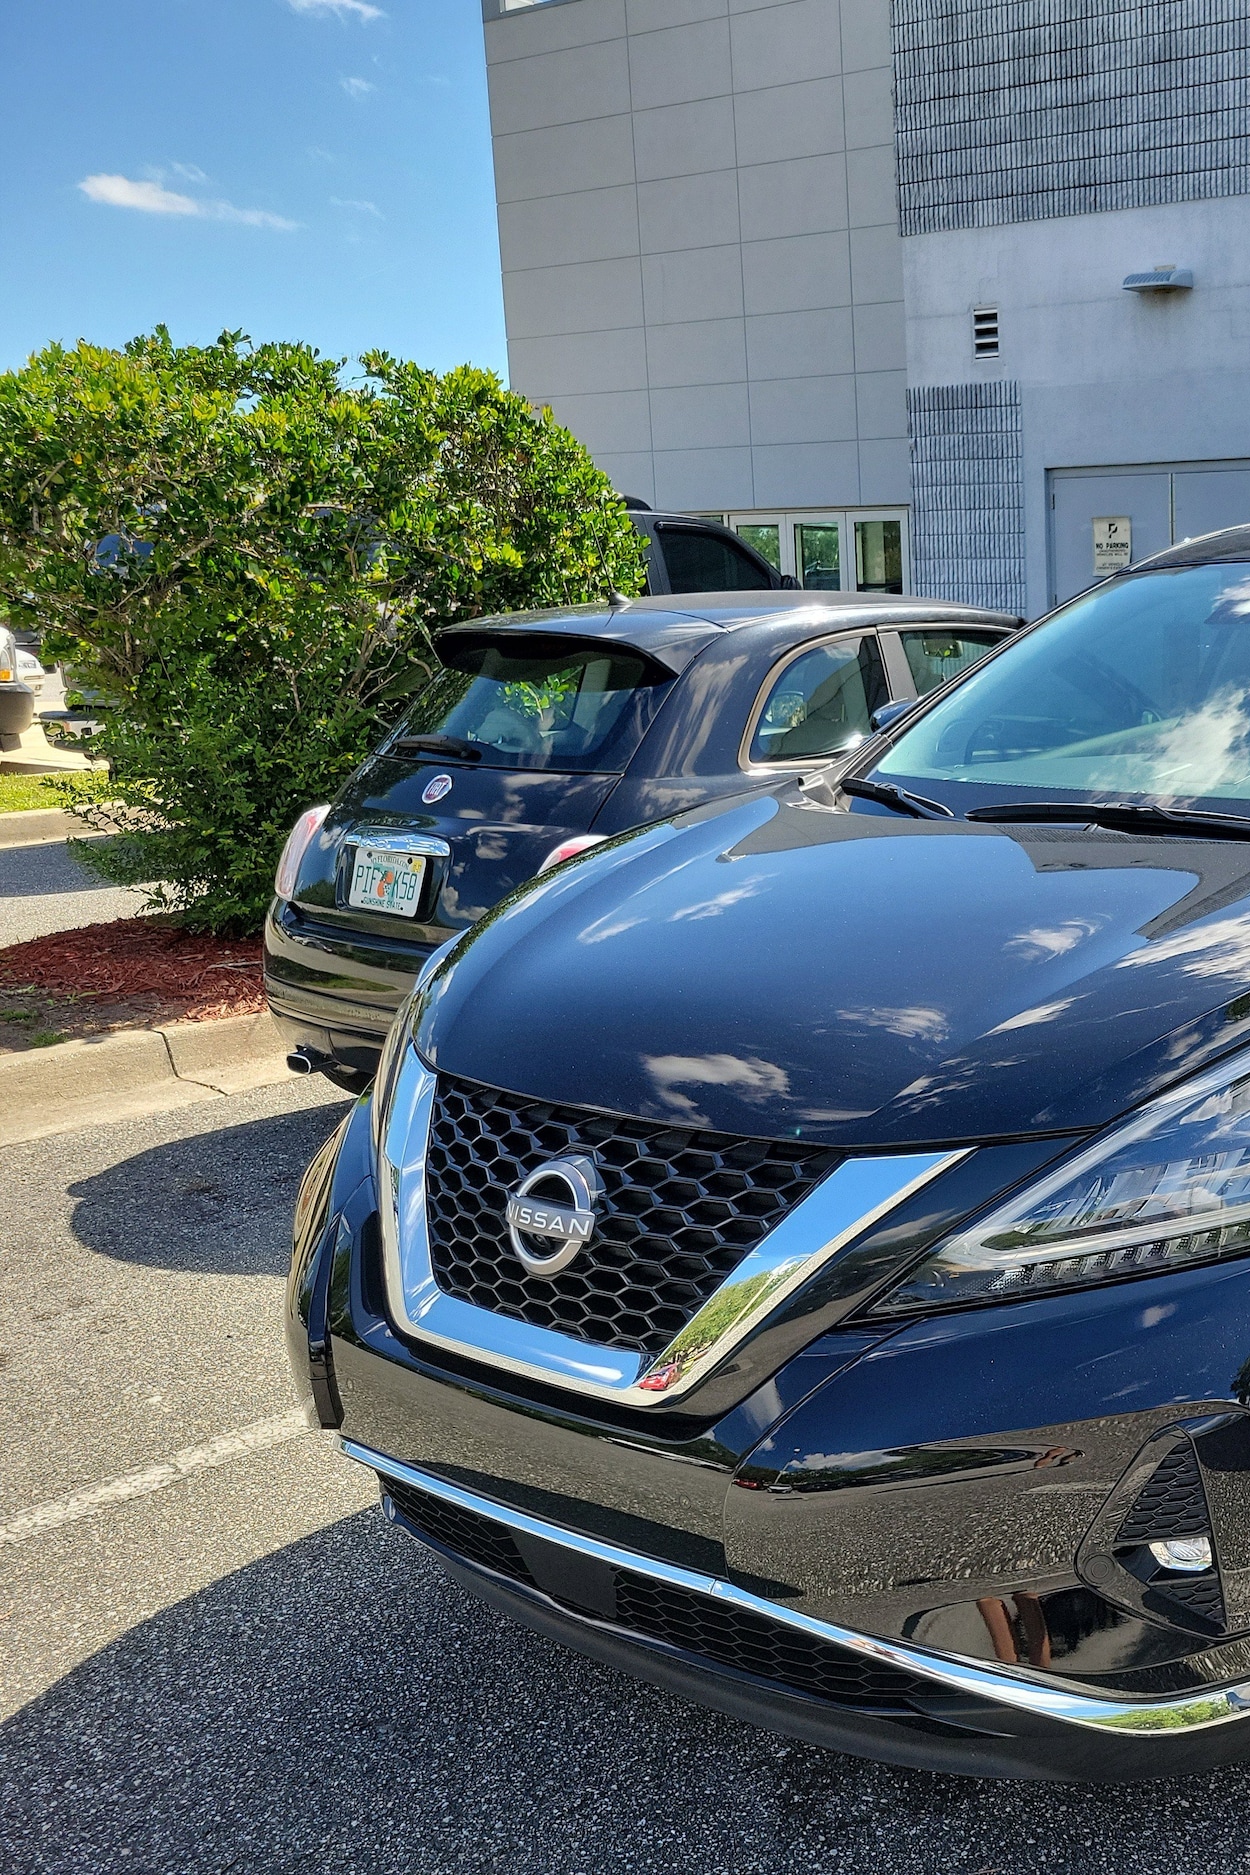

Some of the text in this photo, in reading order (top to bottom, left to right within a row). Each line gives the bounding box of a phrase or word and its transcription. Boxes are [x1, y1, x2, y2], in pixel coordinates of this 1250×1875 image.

[1095, 542, 1104, 550] NO
[354, 865, 418, 901] PIF K58
[364, 896, 401, 911] SUNSHINE STATE
[506, 1200, 590, 1236] NISSAN
